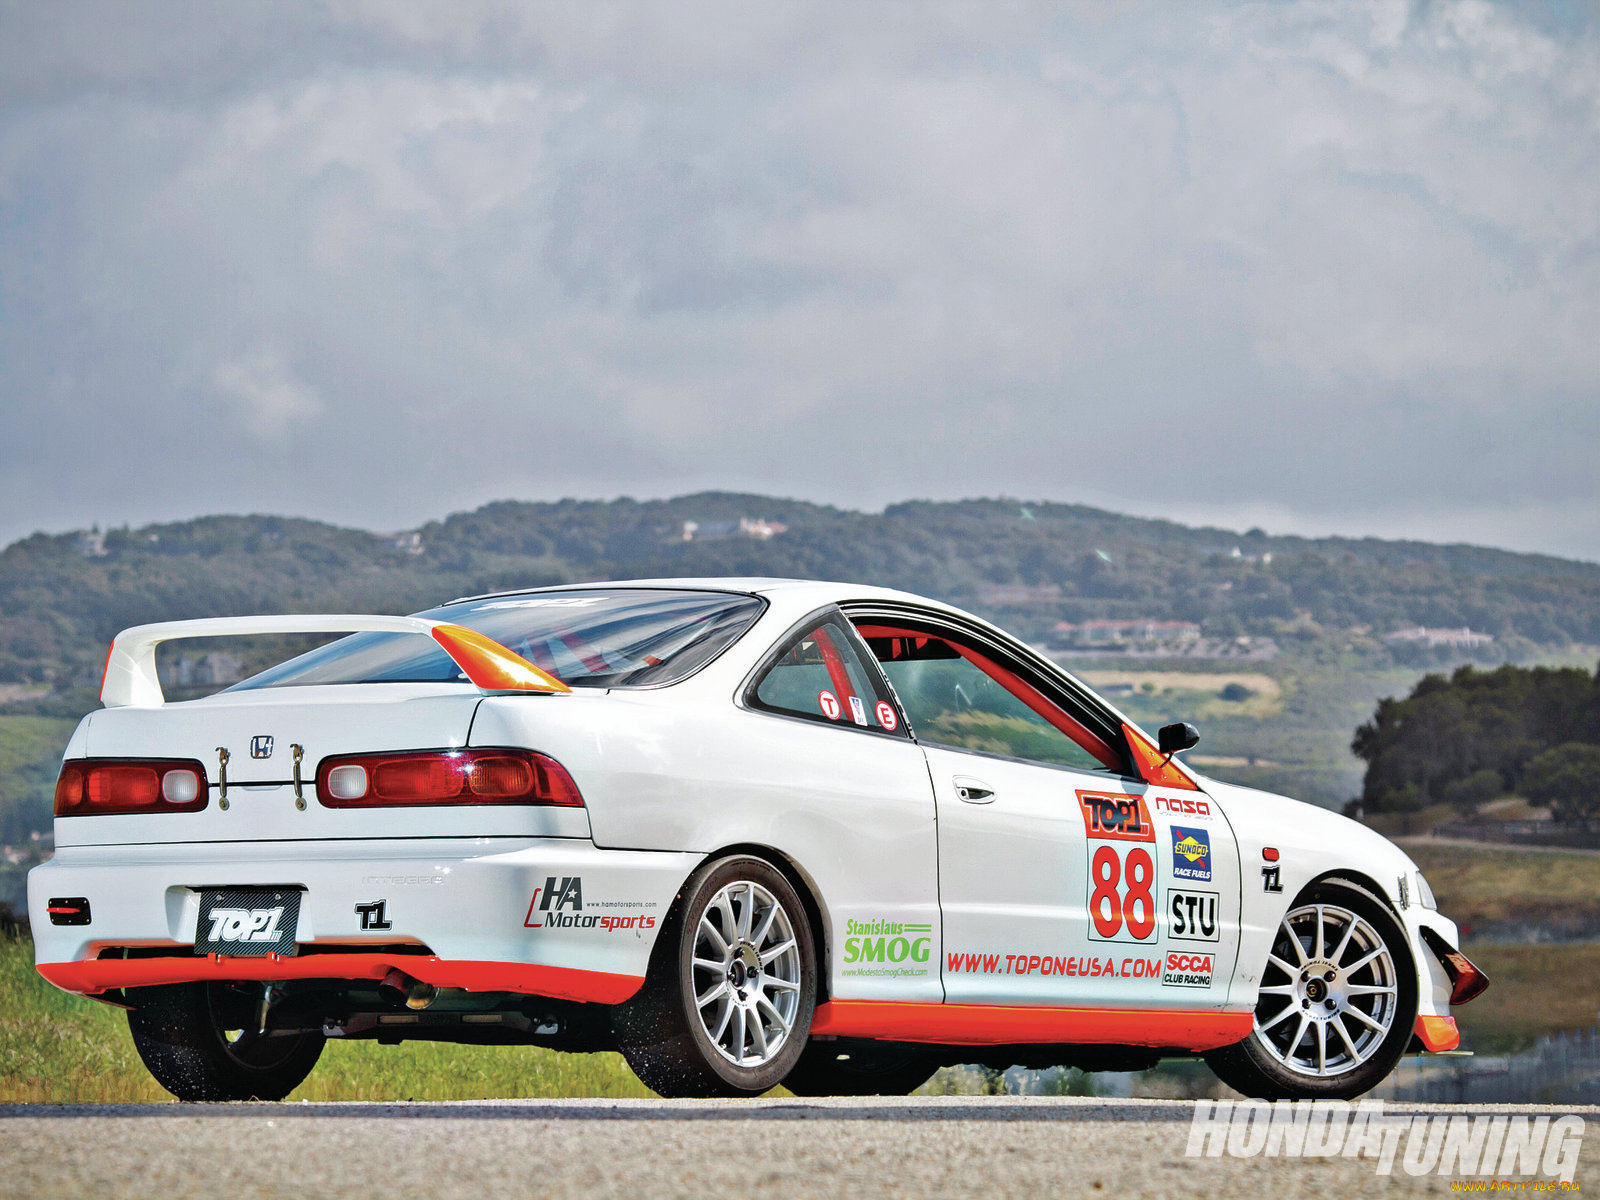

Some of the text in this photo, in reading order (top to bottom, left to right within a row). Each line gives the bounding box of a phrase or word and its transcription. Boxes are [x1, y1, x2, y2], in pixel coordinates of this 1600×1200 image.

[823, 698, 834, 715] T
[880, 707, 893, 725] E
[1082, 796, 1147, 834] TOP1
[1176, 843, 1207, 855] SUNOCO
[1174, 867, 1211, 880] RACE FUELS
[1262, 865, 1284, 894] T1
[539, 877, 583, 911] HA
[1090, 846, 1155, 939] 88
[208, 907, 284, 942] TOP1
[354, 899, 392, 931] T1
[545, 911, 656, 932] Motorsports
[846, 918, 904, 935] Stanislaus
[1172, 894, 1215, 937] STU
[843, 937, 931, 963] SMOG
[948, 953, 1162, 978] WWW.TOPONEUSA.COM
[1167, 954, 1211, 972] SCCA
[1164, 974, 1210, 985] CLUB RACING
